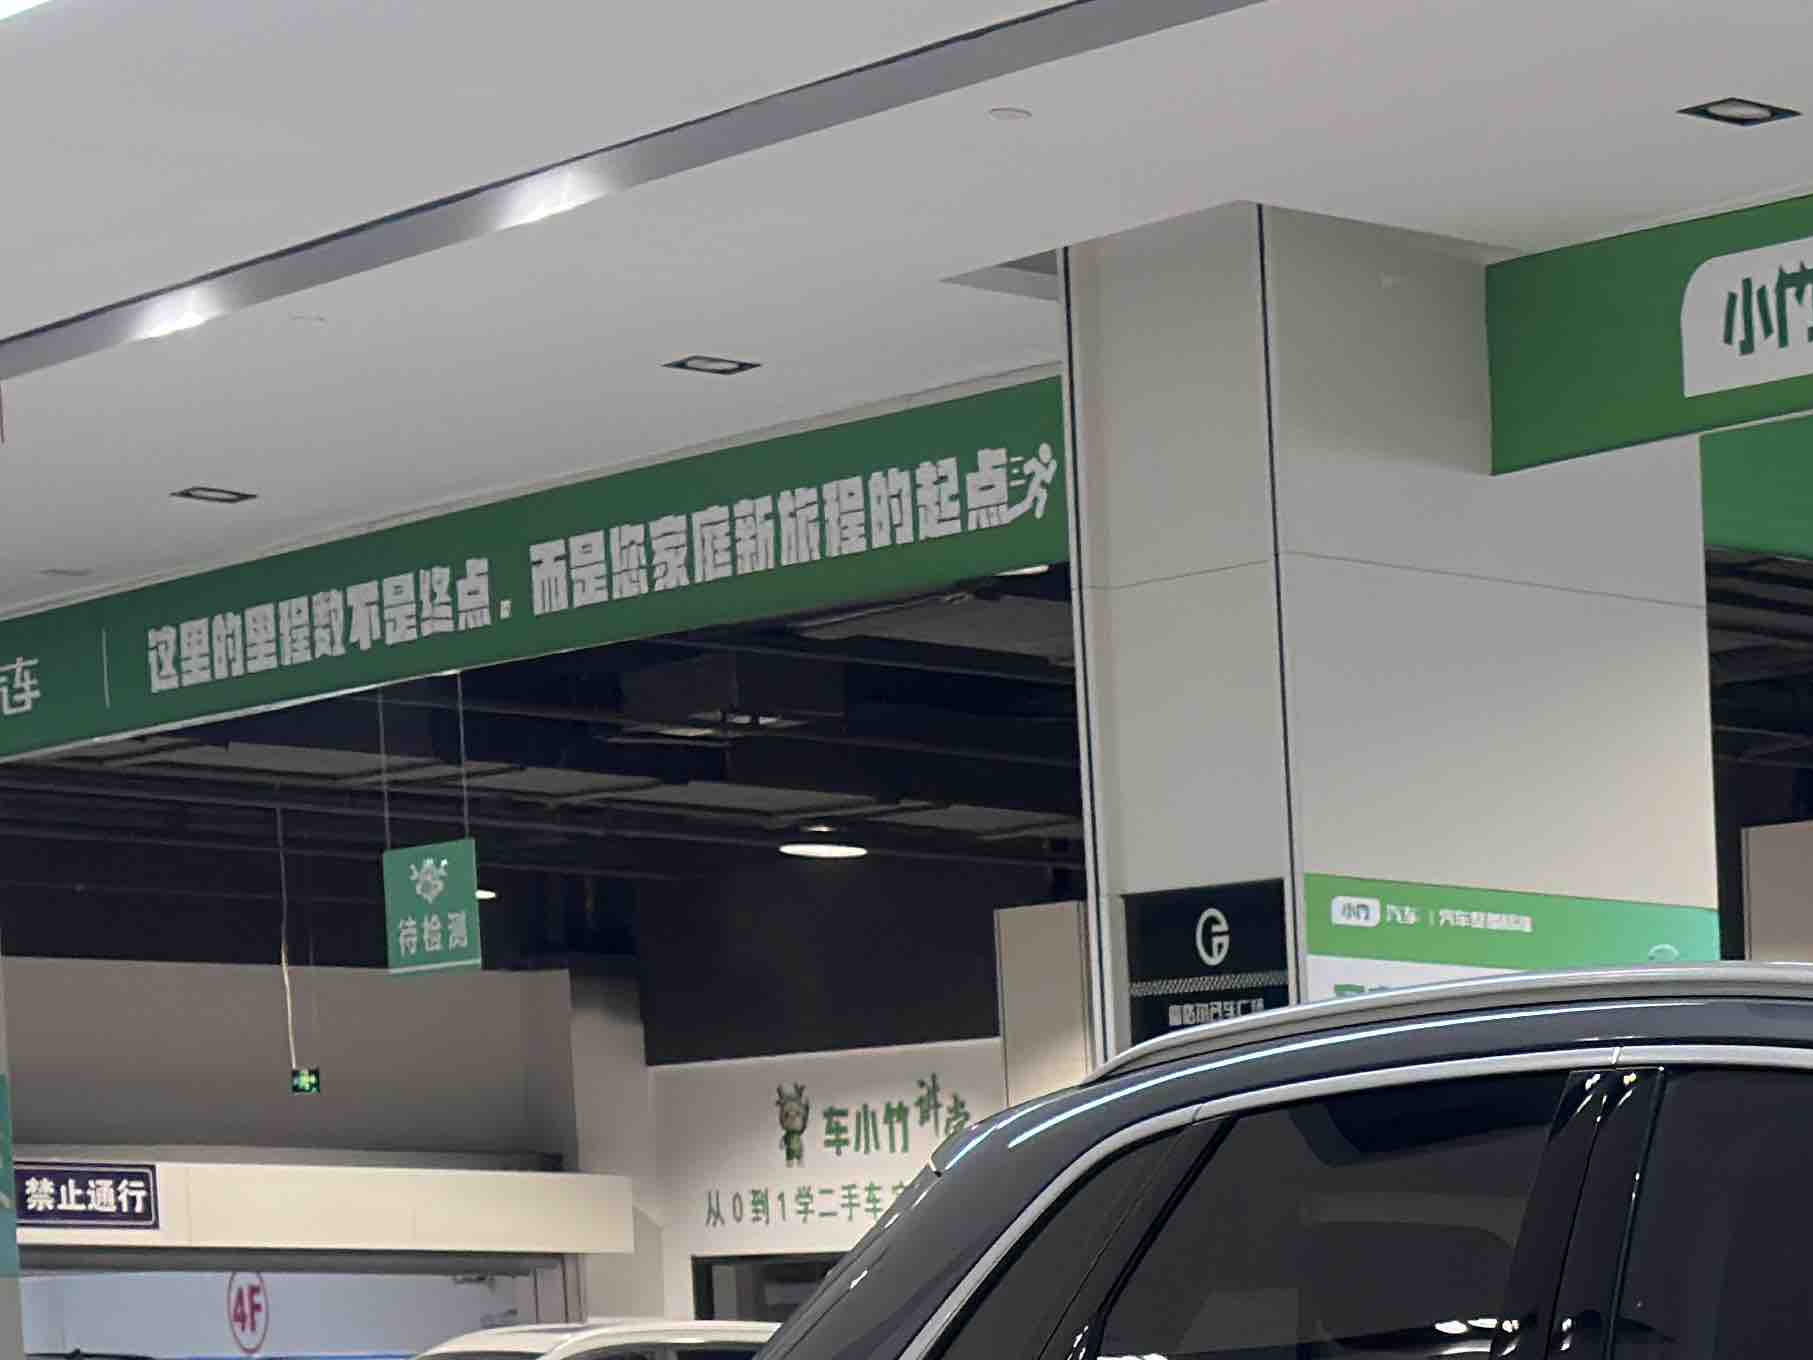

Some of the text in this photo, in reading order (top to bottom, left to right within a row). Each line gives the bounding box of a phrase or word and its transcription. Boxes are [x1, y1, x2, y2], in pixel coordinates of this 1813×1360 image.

[398, 910, 468, 957] 待检测
[25, 1176, 147, 1213] 禁止通行
[706, 1180, 904, 1228] 从0到1学二手车
[232, 1284, 262, 1332] 4F
